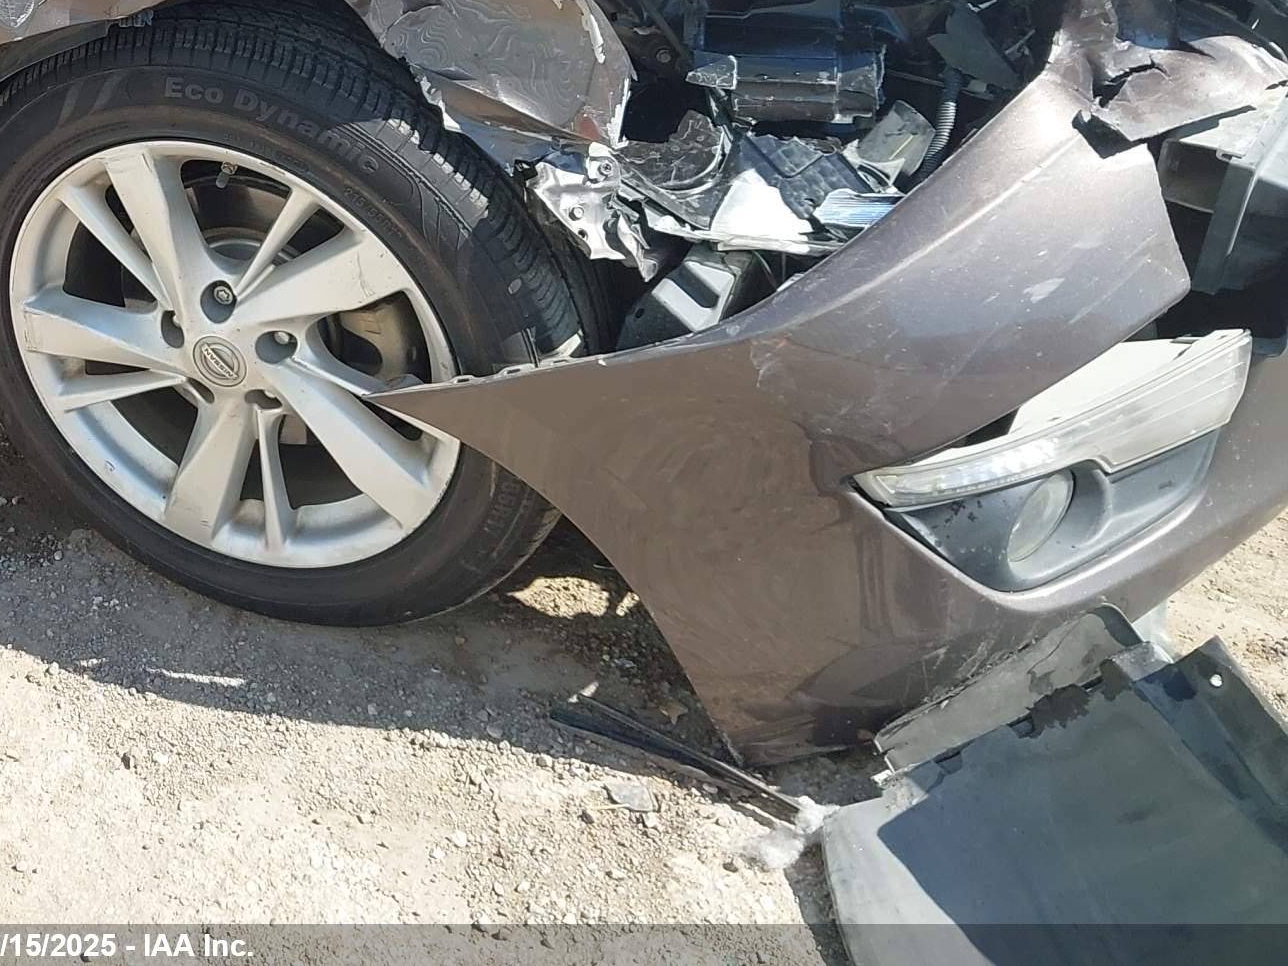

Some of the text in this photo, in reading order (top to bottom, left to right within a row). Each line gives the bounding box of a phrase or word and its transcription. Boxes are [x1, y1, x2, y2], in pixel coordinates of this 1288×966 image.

[164, 77, 224, 104] Eco
[234, 89, 379, 173] Dynamic
[204, 347, 234, 377] NISSAN
